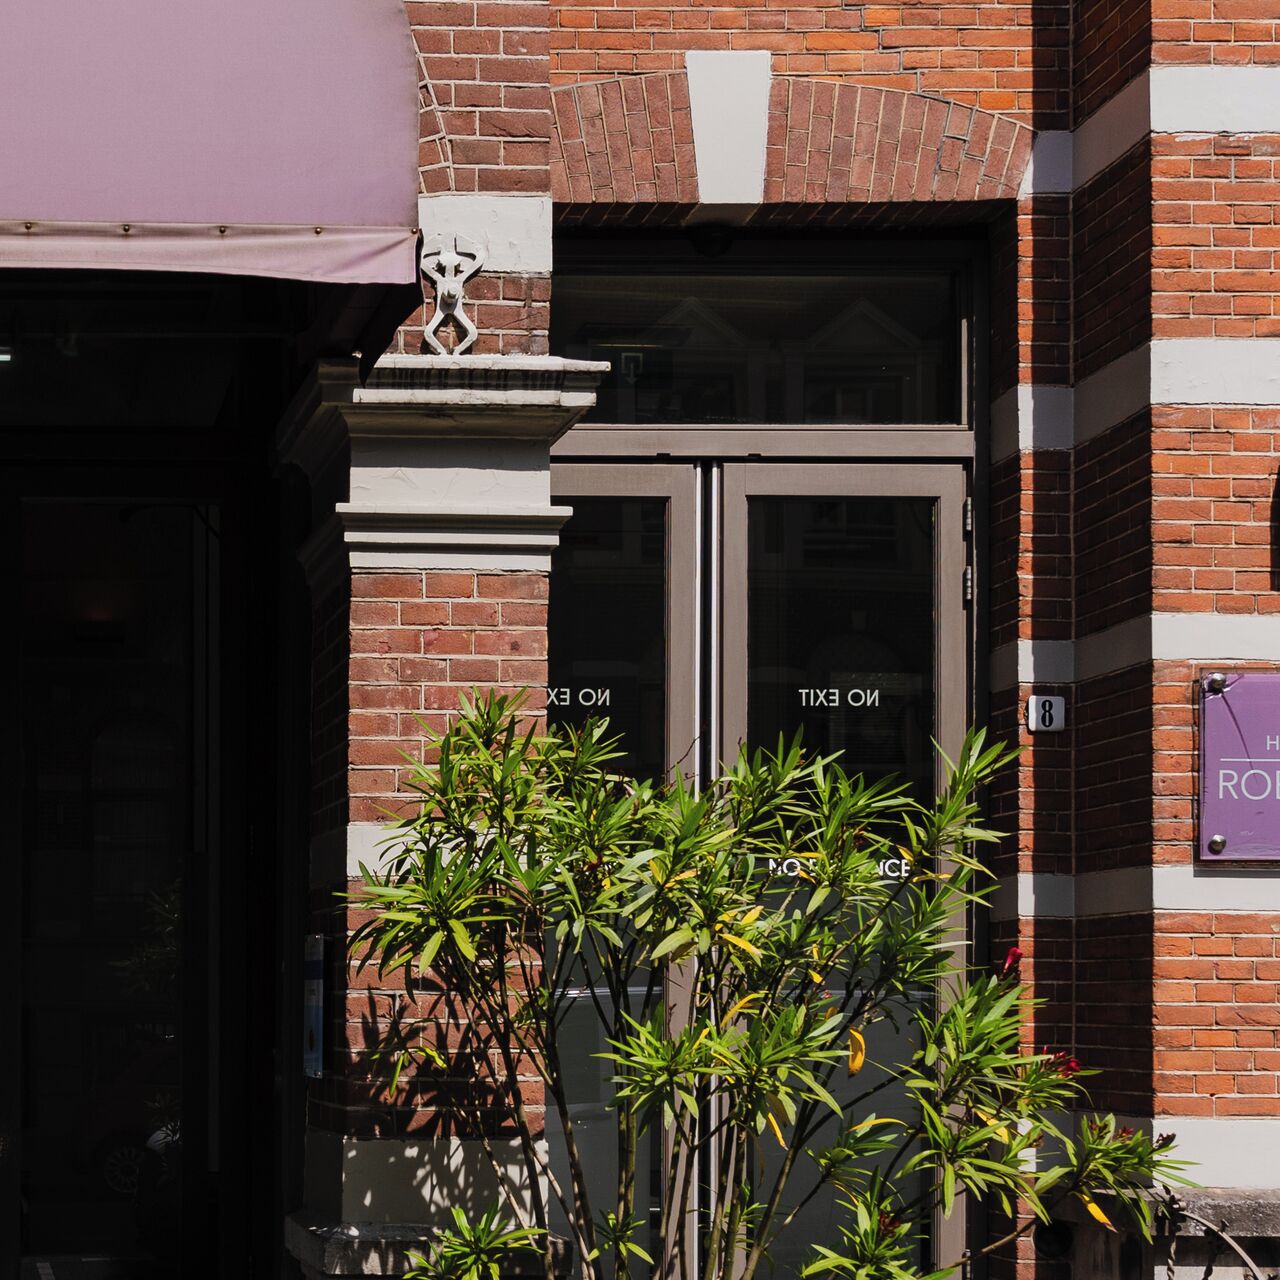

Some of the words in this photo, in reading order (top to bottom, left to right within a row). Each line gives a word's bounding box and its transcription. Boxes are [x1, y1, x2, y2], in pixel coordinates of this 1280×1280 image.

[1041, 699, 1054, 728] 8
[1218, 769, 1280, 801] RO
[768, 858, 801, 876] NO
